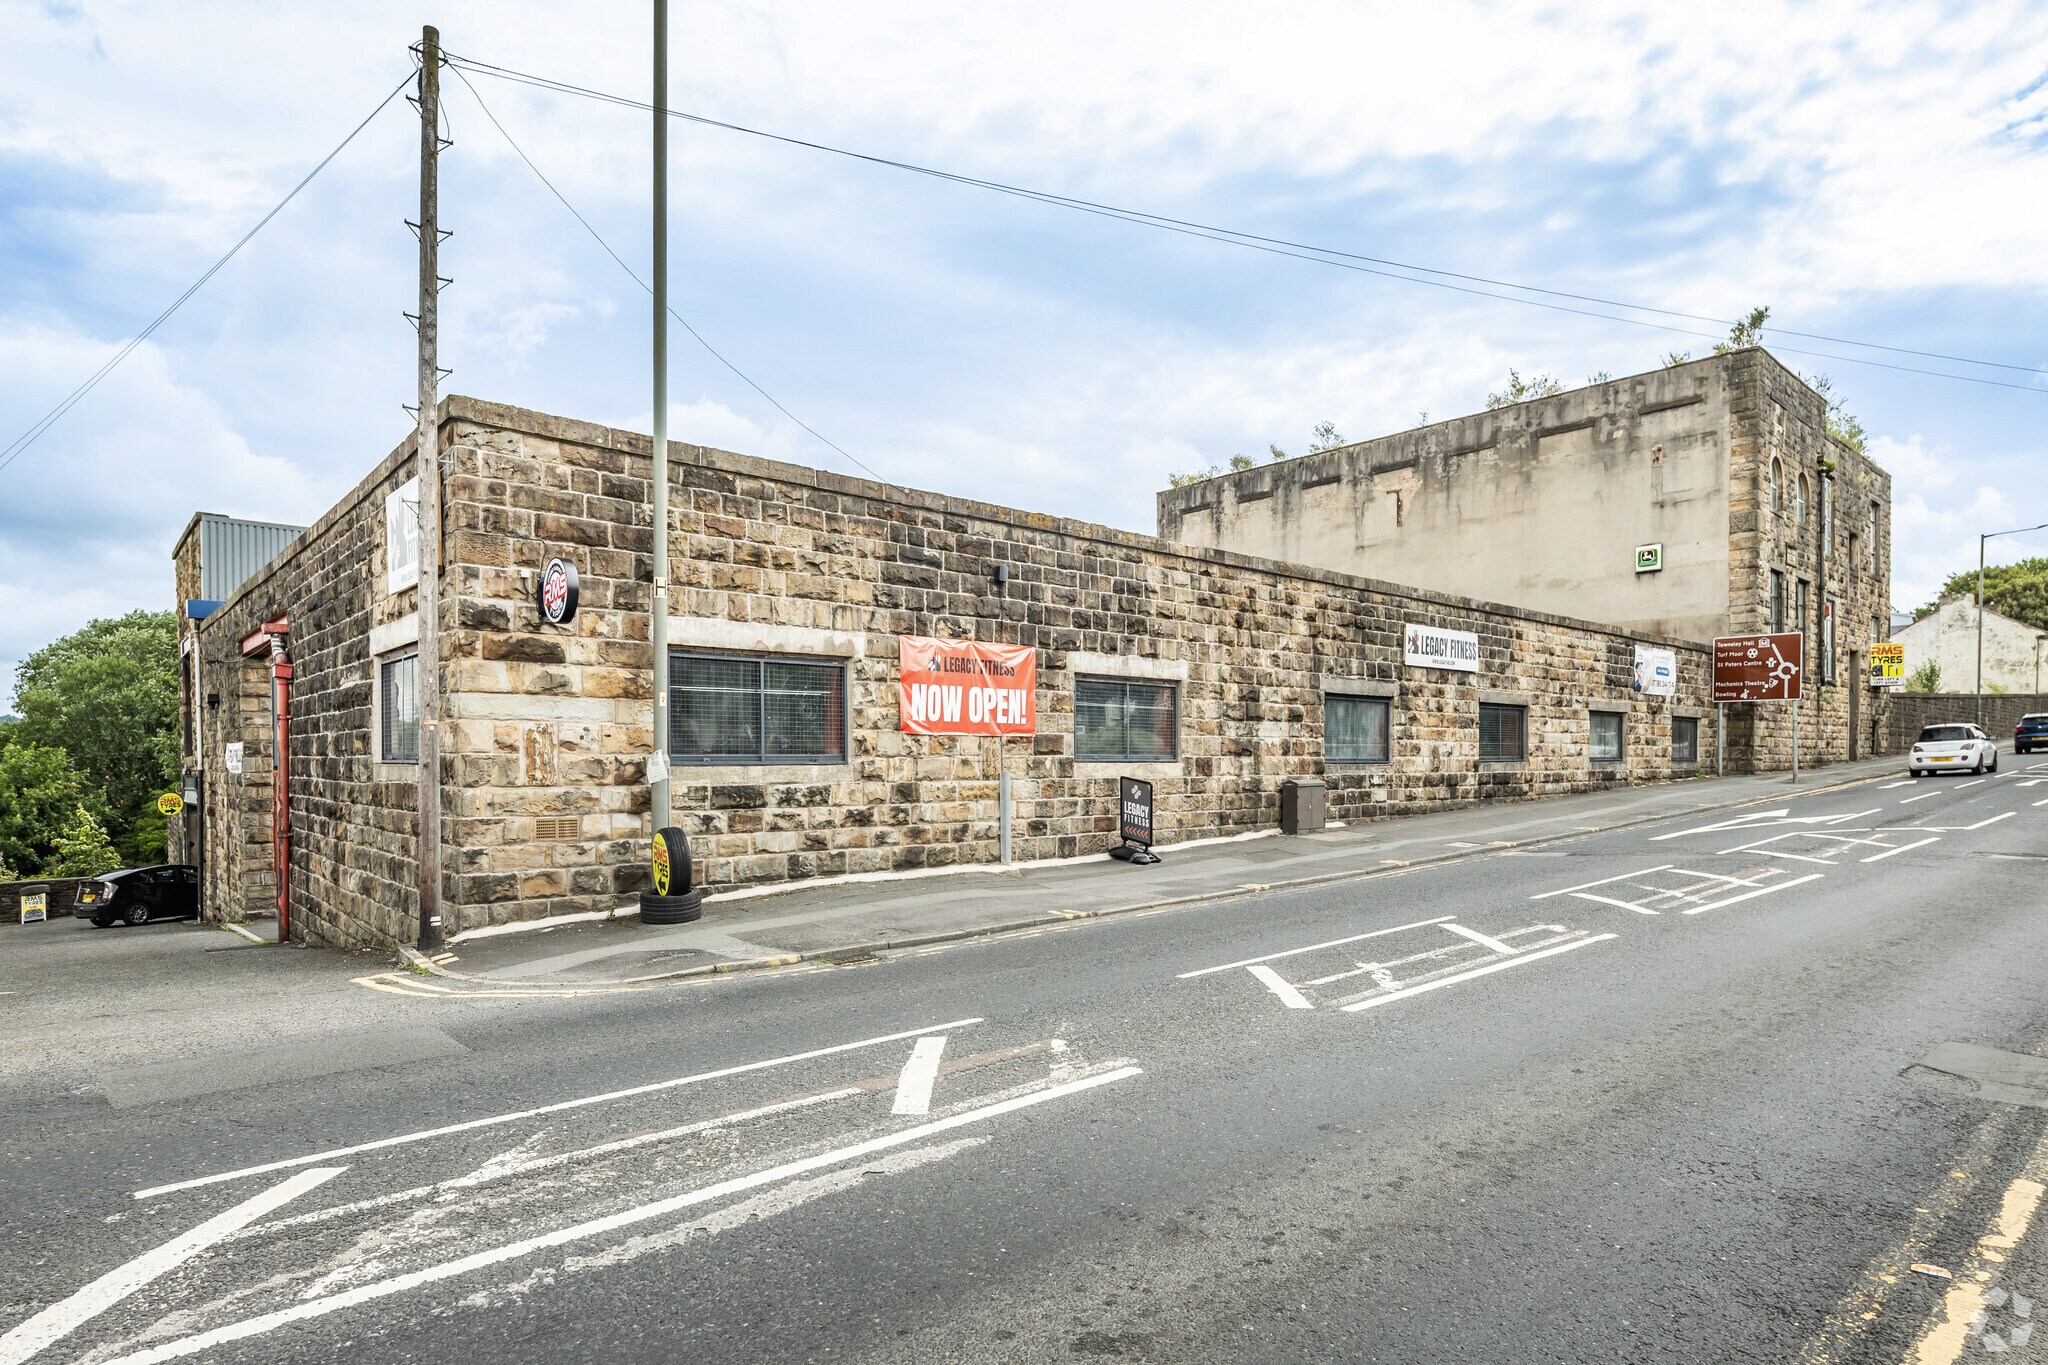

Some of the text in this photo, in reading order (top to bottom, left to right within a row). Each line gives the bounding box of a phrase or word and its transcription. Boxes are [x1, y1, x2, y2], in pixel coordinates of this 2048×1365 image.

[545, 572, 567, 607] RMS
[1421, 635, 1477, 660] LEGACY FITNESS
[1872, 646, 1902, 655] RMS
[943, 656, 1015, 677] LEGACY FITNESS
[1871, 656, 1902, 664] TYRES
[911, 683, 1026, 724] NOW OPEN!
[1124, 801, 1149, 818] LEGACY
[1124, 813, 1149, 827] FITNESS
[654, 844, 668, 864] RMS
[654, 860, 669, 878] TYRES
